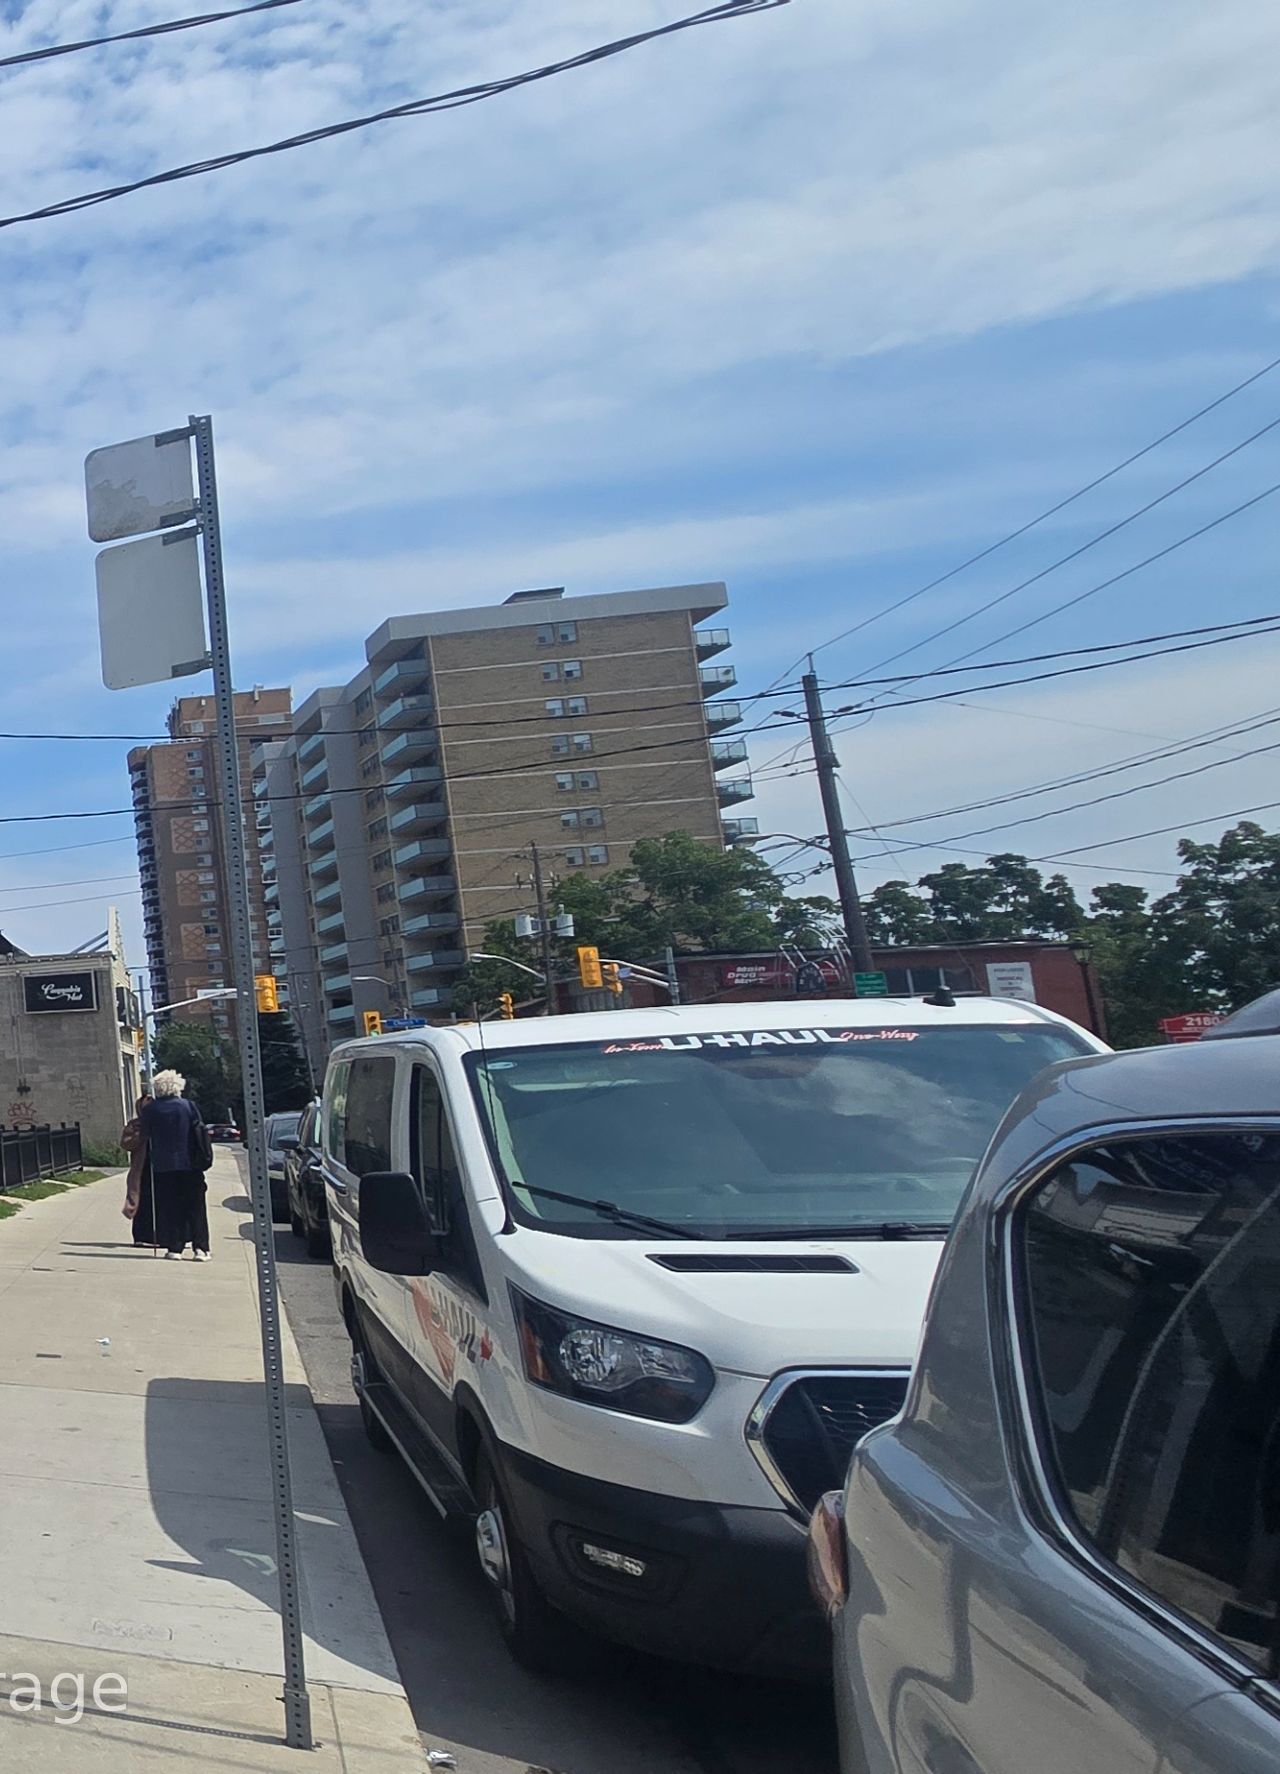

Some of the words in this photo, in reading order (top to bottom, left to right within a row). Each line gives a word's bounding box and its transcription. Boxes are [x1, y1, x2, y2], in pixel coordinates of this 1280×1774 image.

[1185, 1016, 1220, 1026] 2180
[659, 1029, 848, 1051] U-HAUL
[840, 1029, 920, 1041] One-Way
